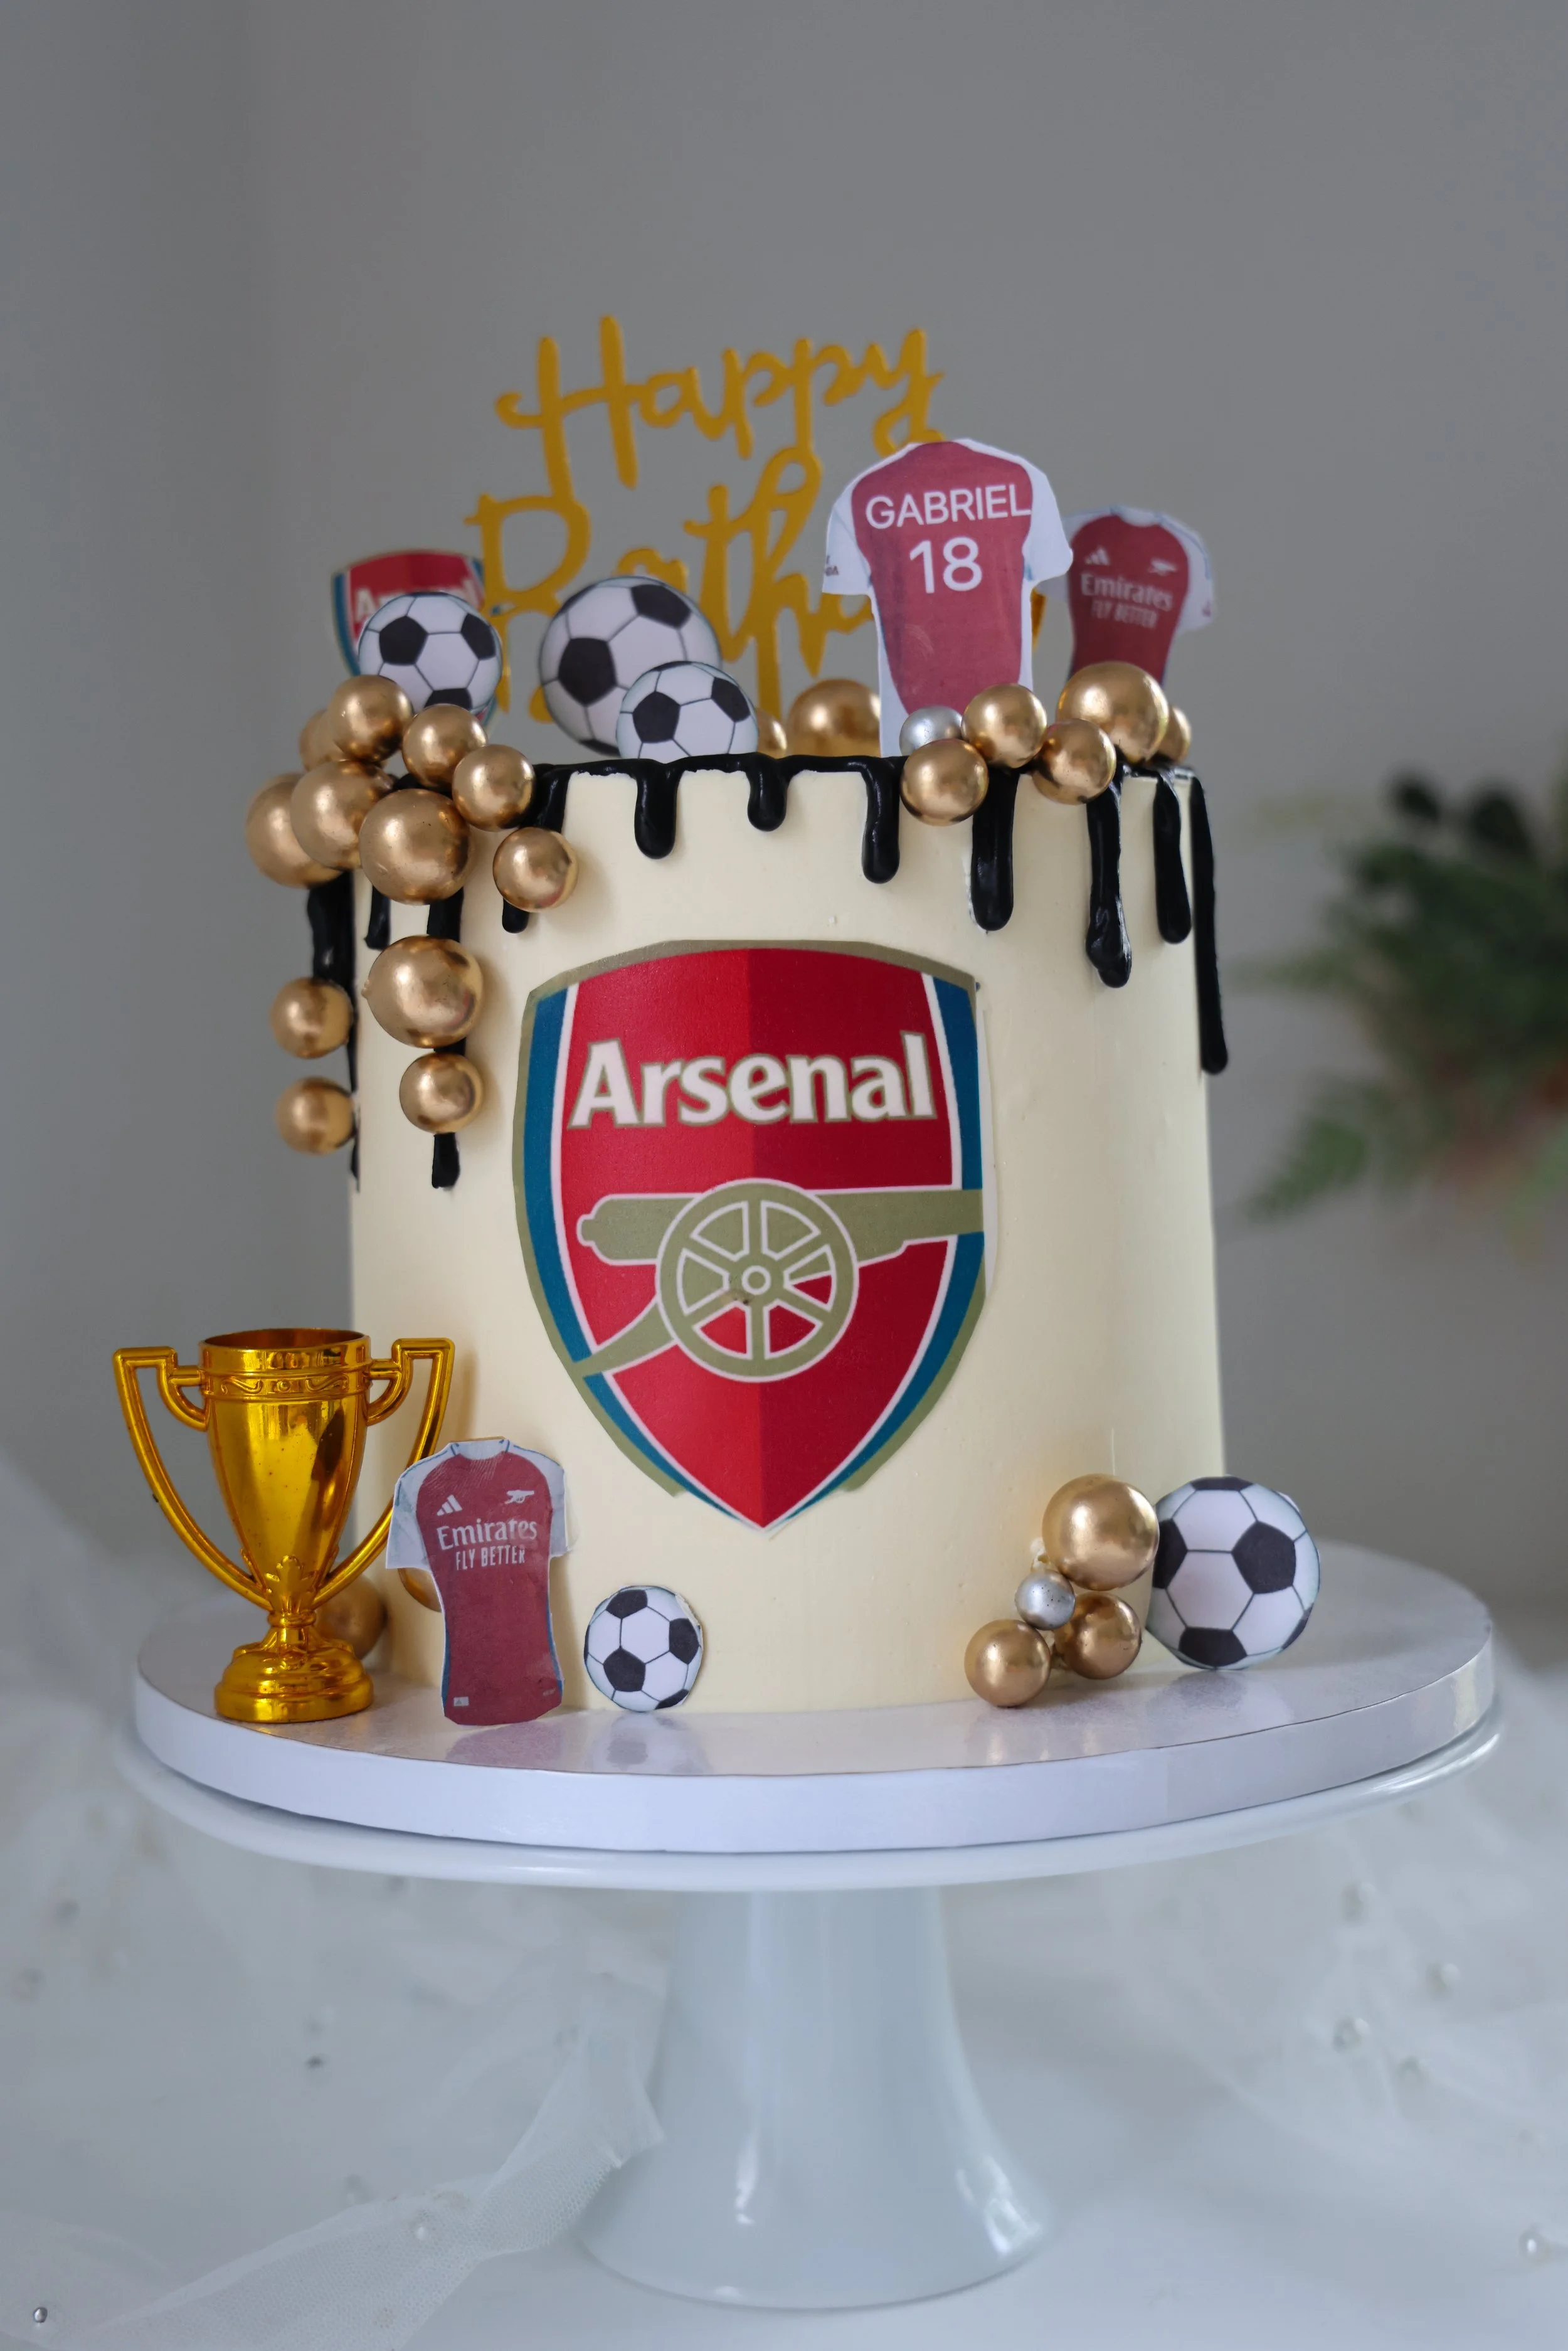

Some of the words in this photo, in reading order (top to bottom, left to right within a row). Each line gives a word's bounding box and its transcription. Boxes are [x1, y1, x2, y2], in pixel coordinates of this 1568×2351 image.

[495, 315, 945, 494] Happy
[865, 484, 1032, 530] GABRIEL
[909, 536, 982, 594] 18
[567, 1030, 937, 1130] Arsenal
[437, 1518, 538, 1551] Emirates
[456, 1549, 476, 1571] FLY
[481, 1544, 526, 1567] BETTER
